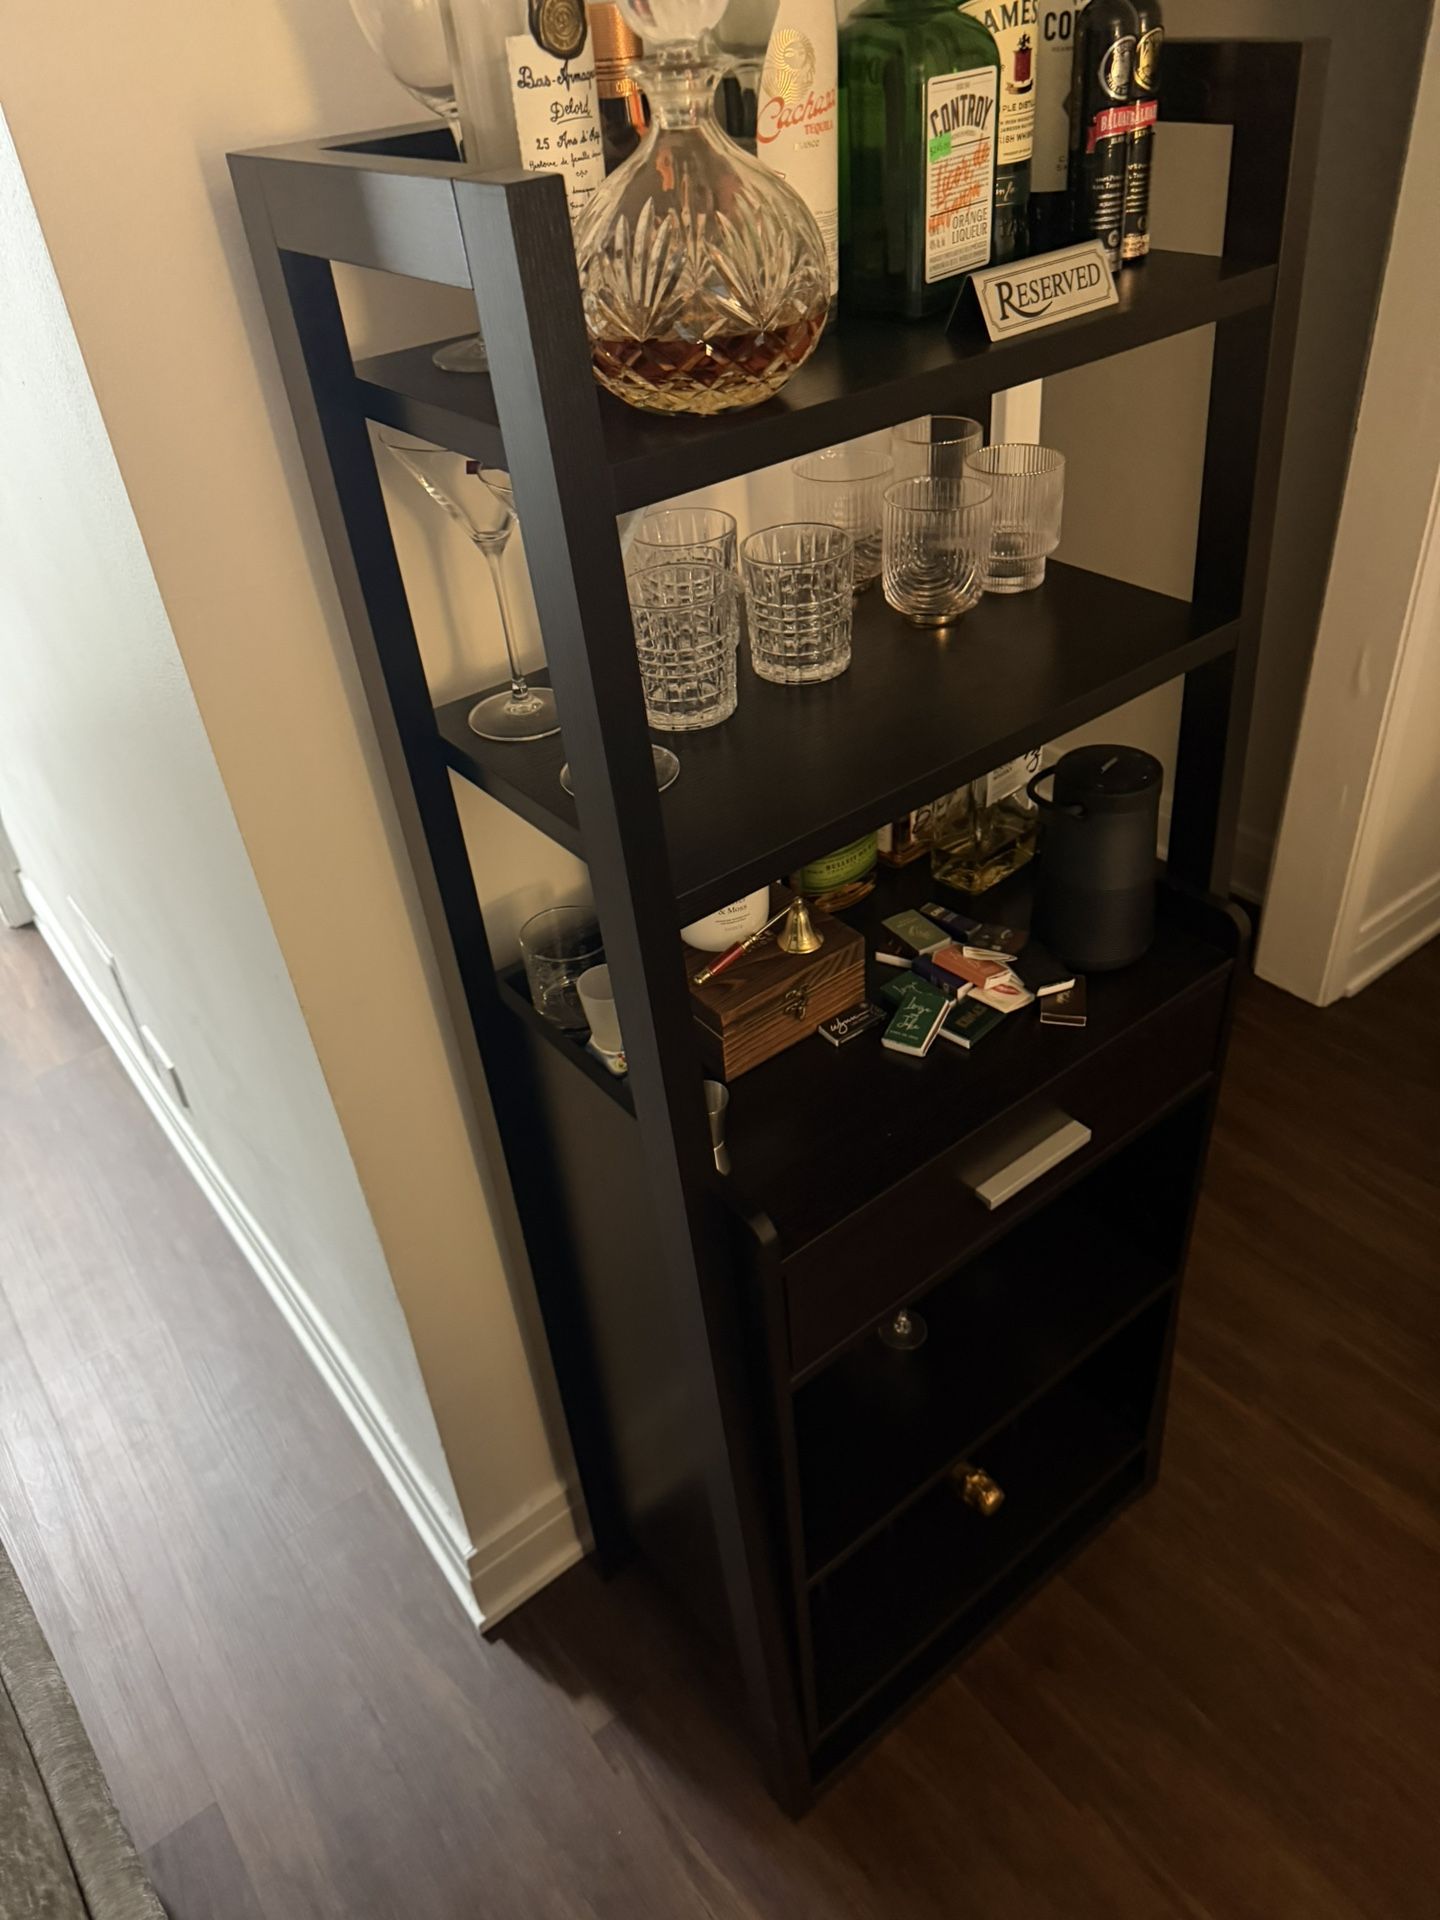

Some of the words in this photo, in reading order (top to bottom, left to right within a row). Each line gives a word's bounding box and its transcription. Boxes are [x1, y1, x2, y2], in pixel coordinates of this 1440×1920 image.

[930, 94, 994, 138] CONTROY
[536, 138, 550, 150] 25
[951, 208, 988, 229] ORANGE
[951, 221, 988, 245] LIQUEUR
[995, 262, 1101, 321] RESERVED
